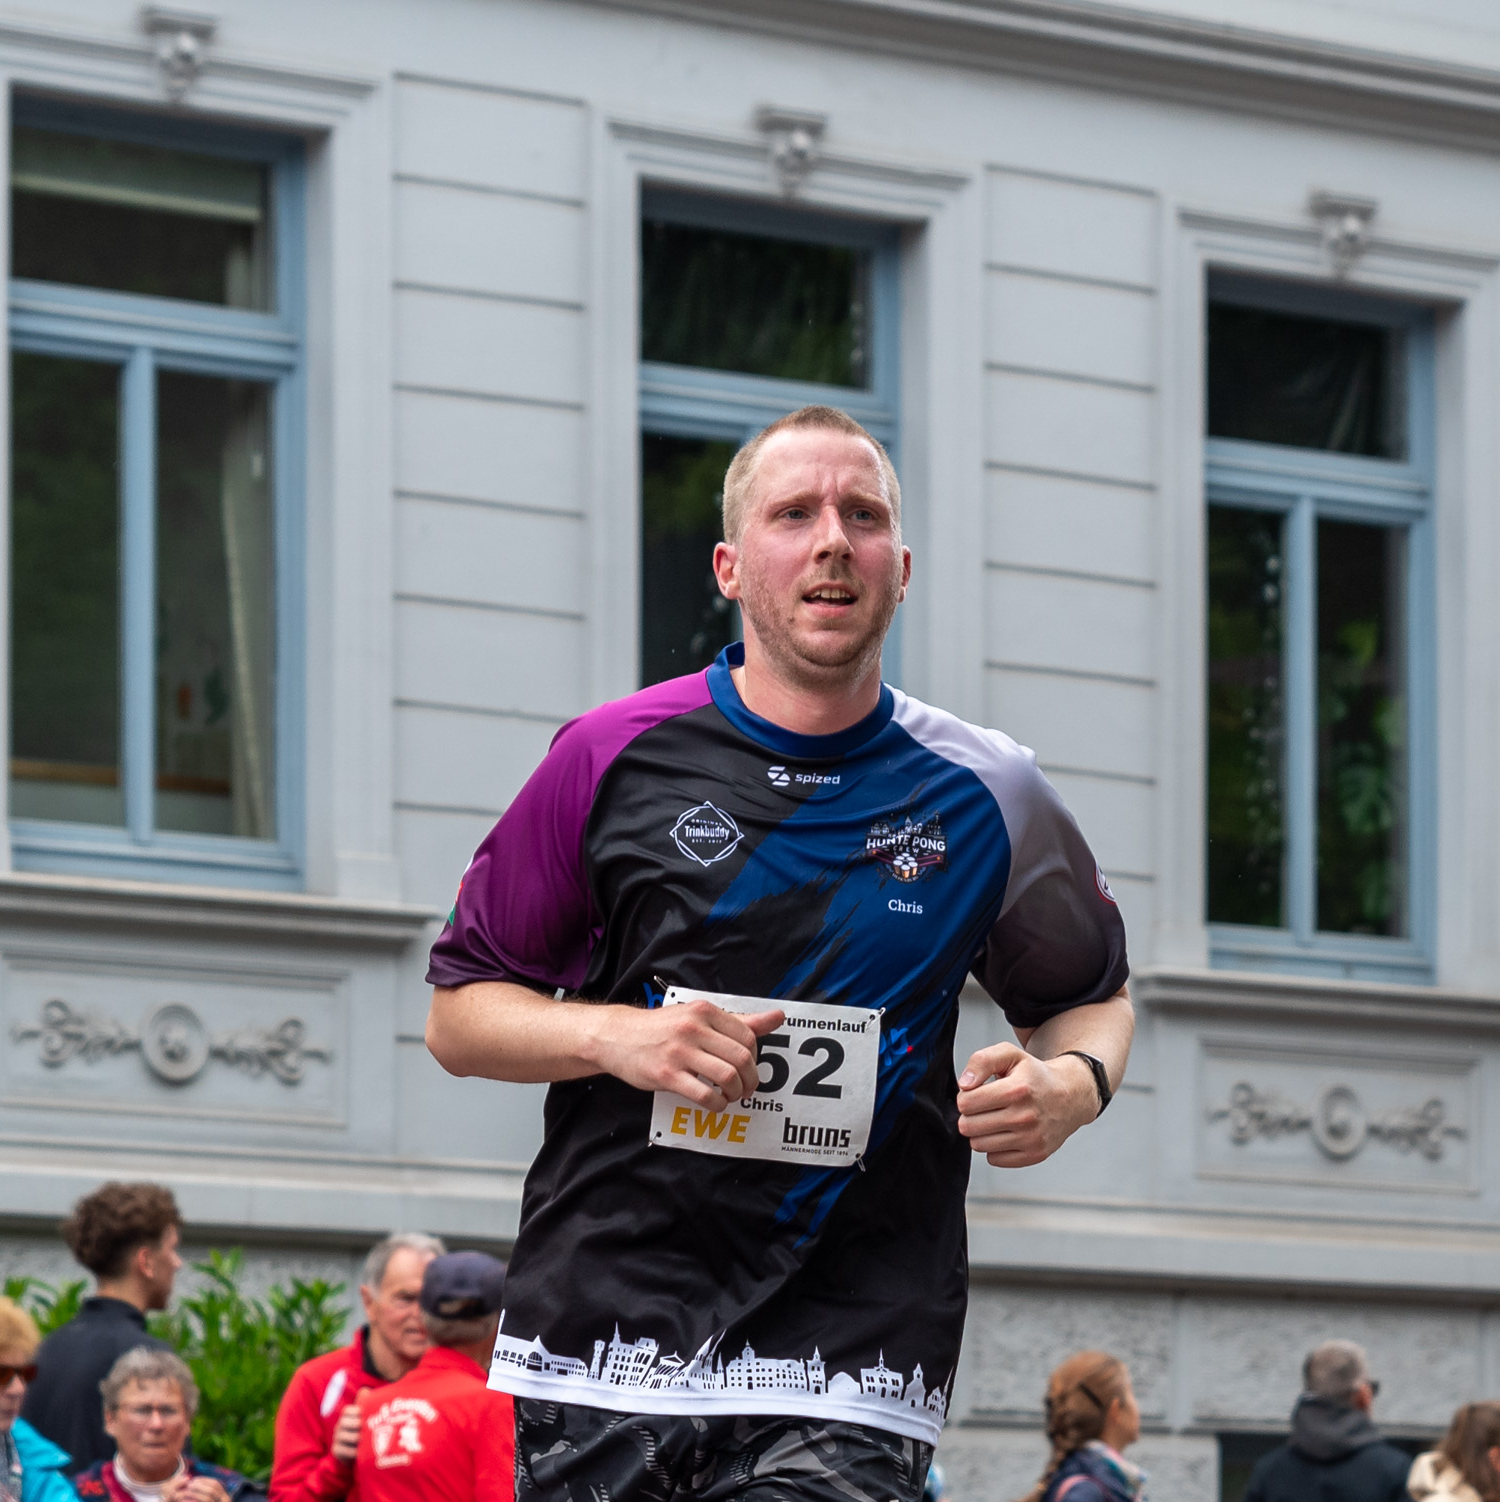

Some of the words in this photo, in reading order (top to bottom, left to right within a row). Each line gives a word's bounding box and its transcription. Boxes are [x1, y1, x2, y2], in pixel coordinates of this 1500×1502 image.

[795, 772, 841, 785] spized
[684, 825, 730, 841] Trinkbuddy
[866, 834, 911, 850] HUNTE
[912, 836, 946, 852] PONG
[893, 845, 920, 853] CREW
[888, 898, 923, 914] Chris
[781, 1014, 867, 1034] unnenlauf
[754, 1033, 846, 1100] 52
[740, 1097, 784, 1112] Chris
[670, 1106, 751, 1144] EWE
[782, 1116, 851, 1148] bruns
